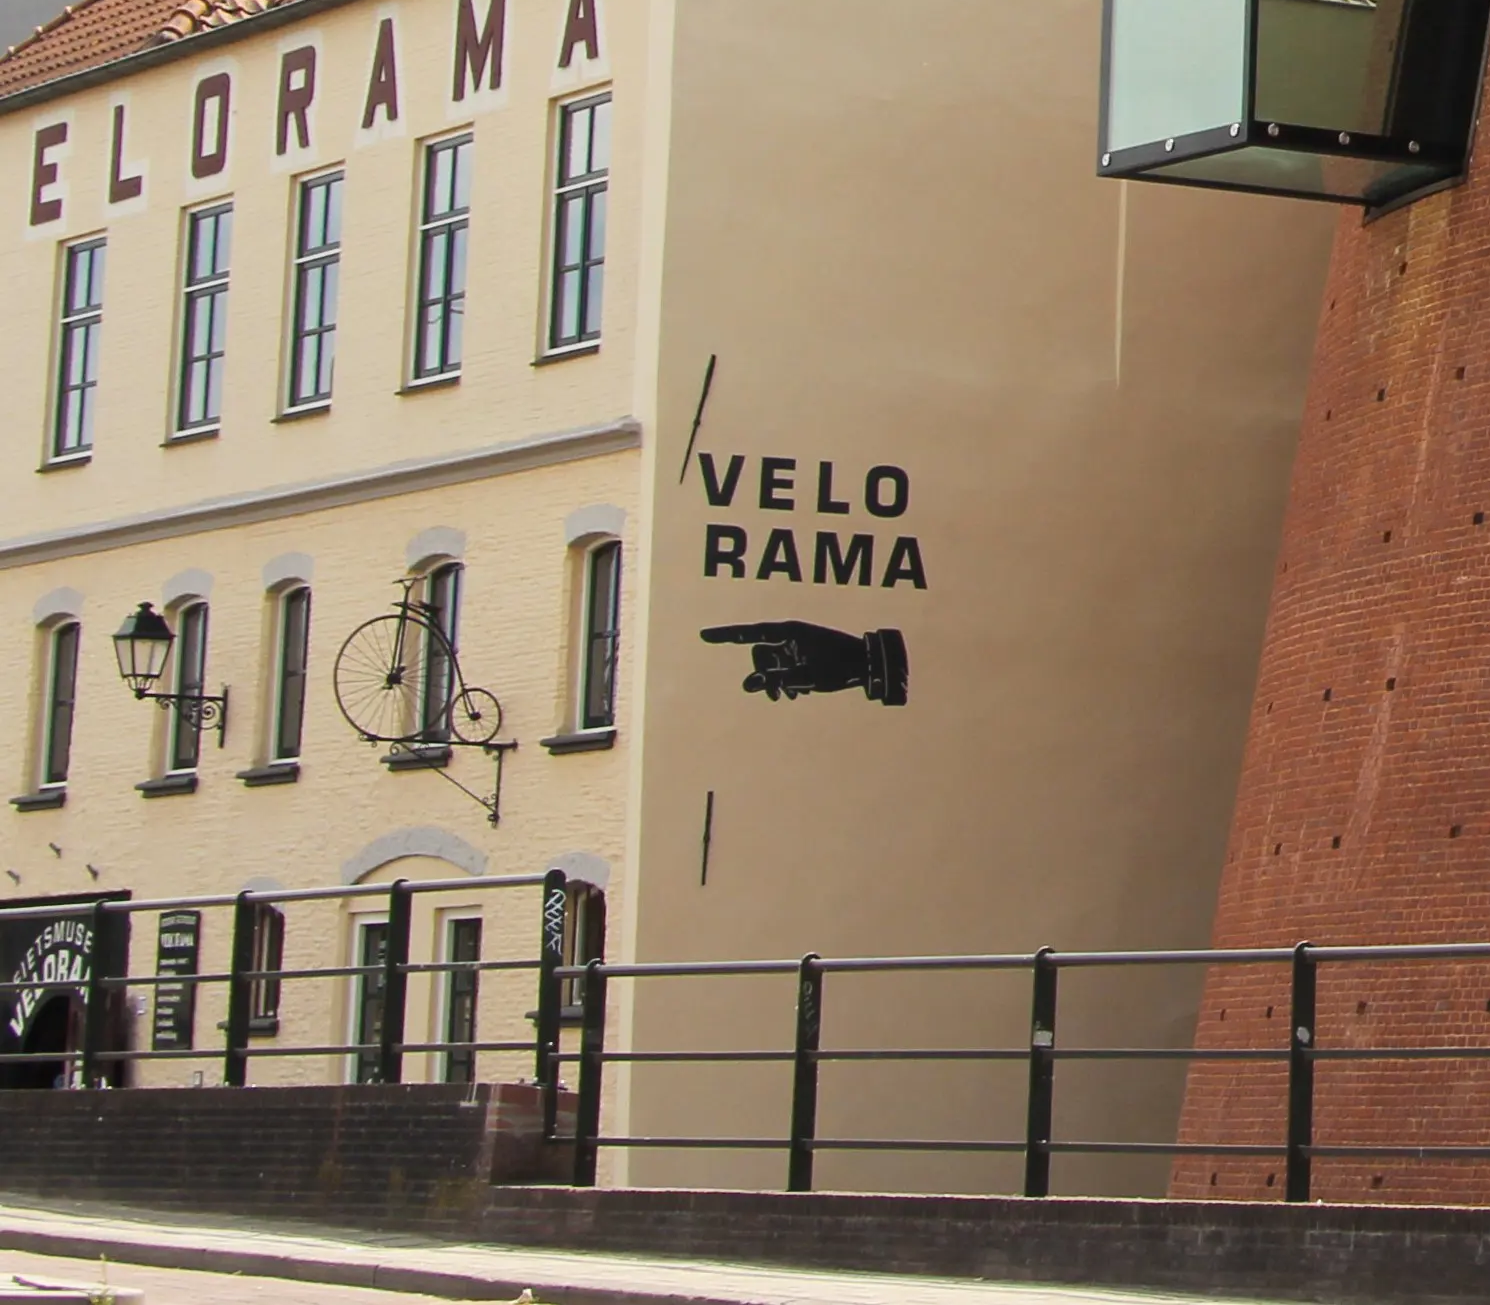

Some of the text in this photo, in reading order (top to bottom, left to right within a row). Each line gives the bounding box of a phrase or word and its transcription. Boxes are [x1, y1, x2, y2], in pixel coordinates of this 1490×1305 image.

[697, 452, 909, 518] VELO
[703, 523, 928, 590] RAMA
[12, 919, 93, 993] FIETSMUSE
[9, 948, 91, 1036] VELORA
